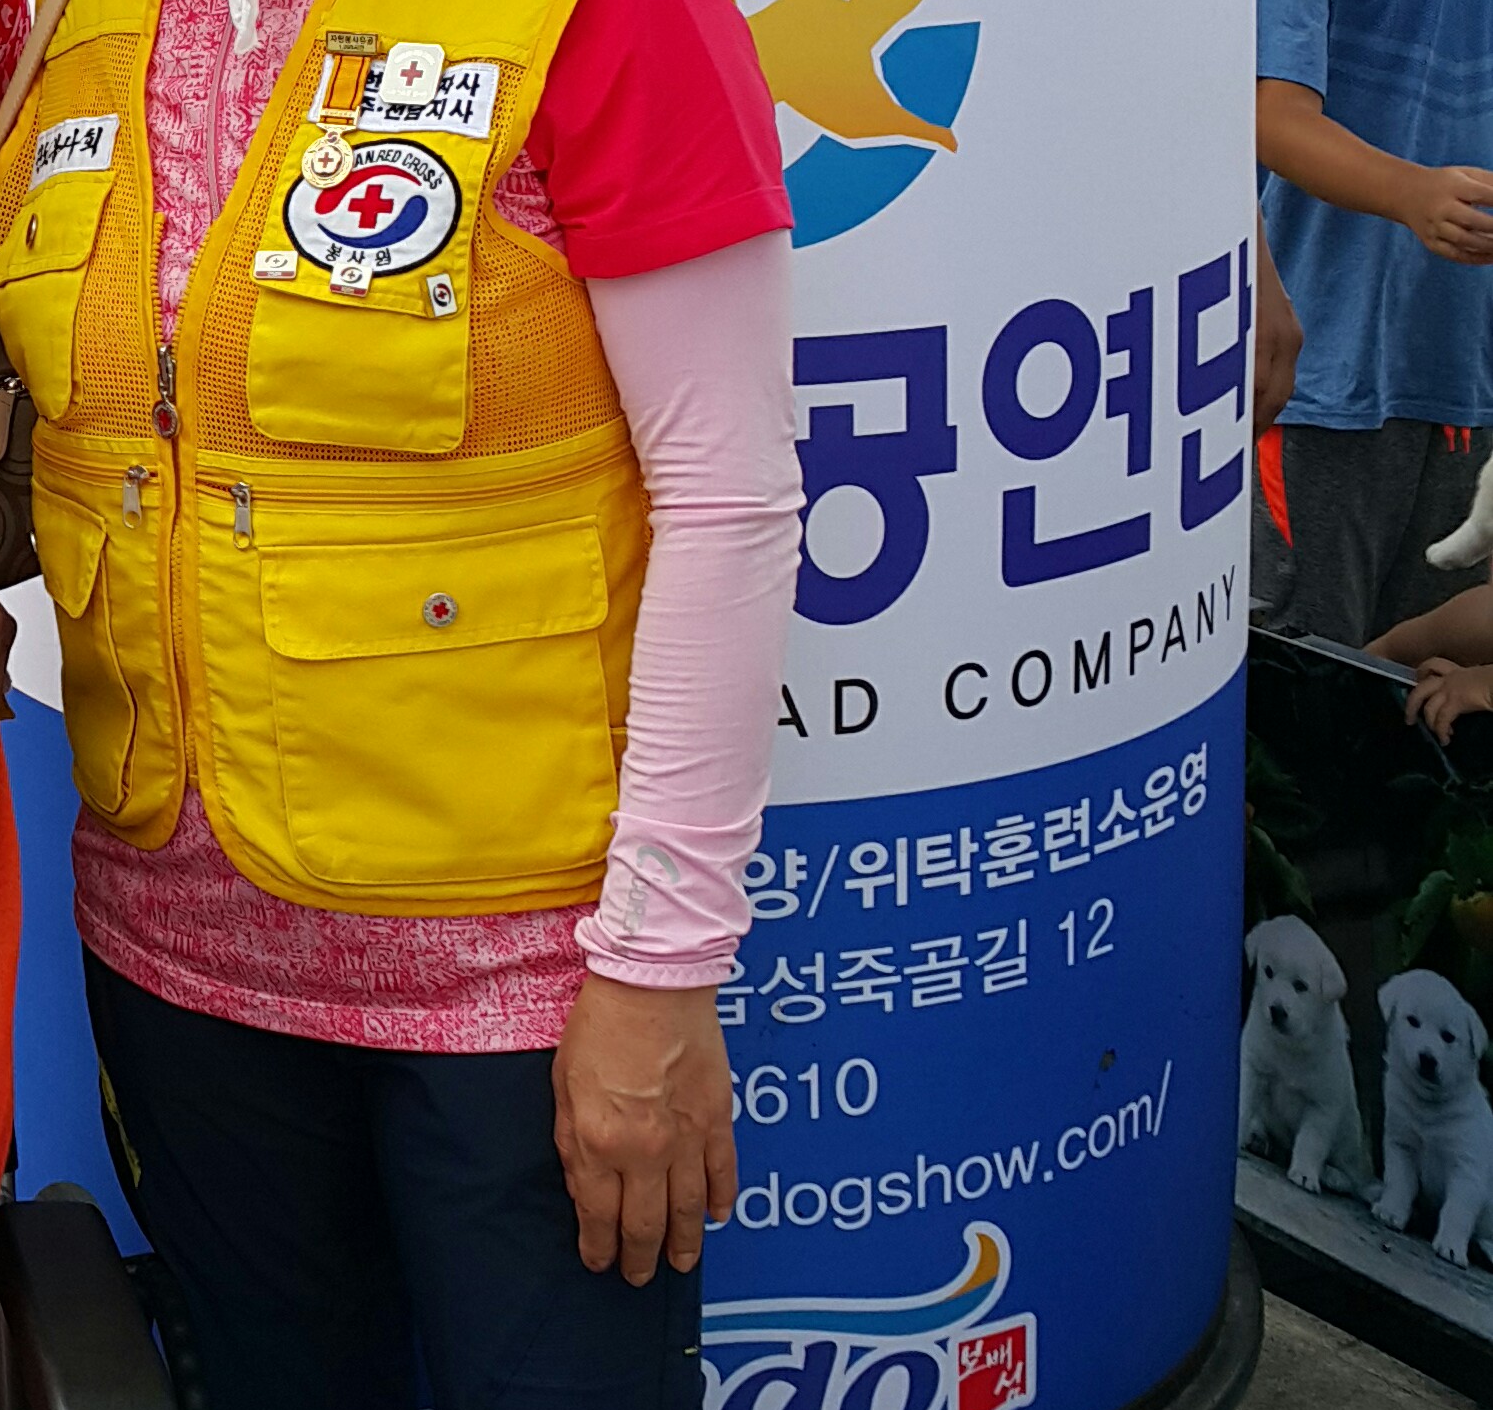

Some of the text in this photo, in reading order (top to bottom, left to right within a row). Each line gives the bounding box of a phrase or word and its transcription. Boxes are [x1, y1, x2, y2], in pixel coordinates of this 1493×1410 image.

[792, 237, 1252, 626] 공연단
[943, 564, 1238, 721] COMPANY
[1057, 897, 1115, 968] 12
[706, 1059, 1174, 1231] dogshow.com/
